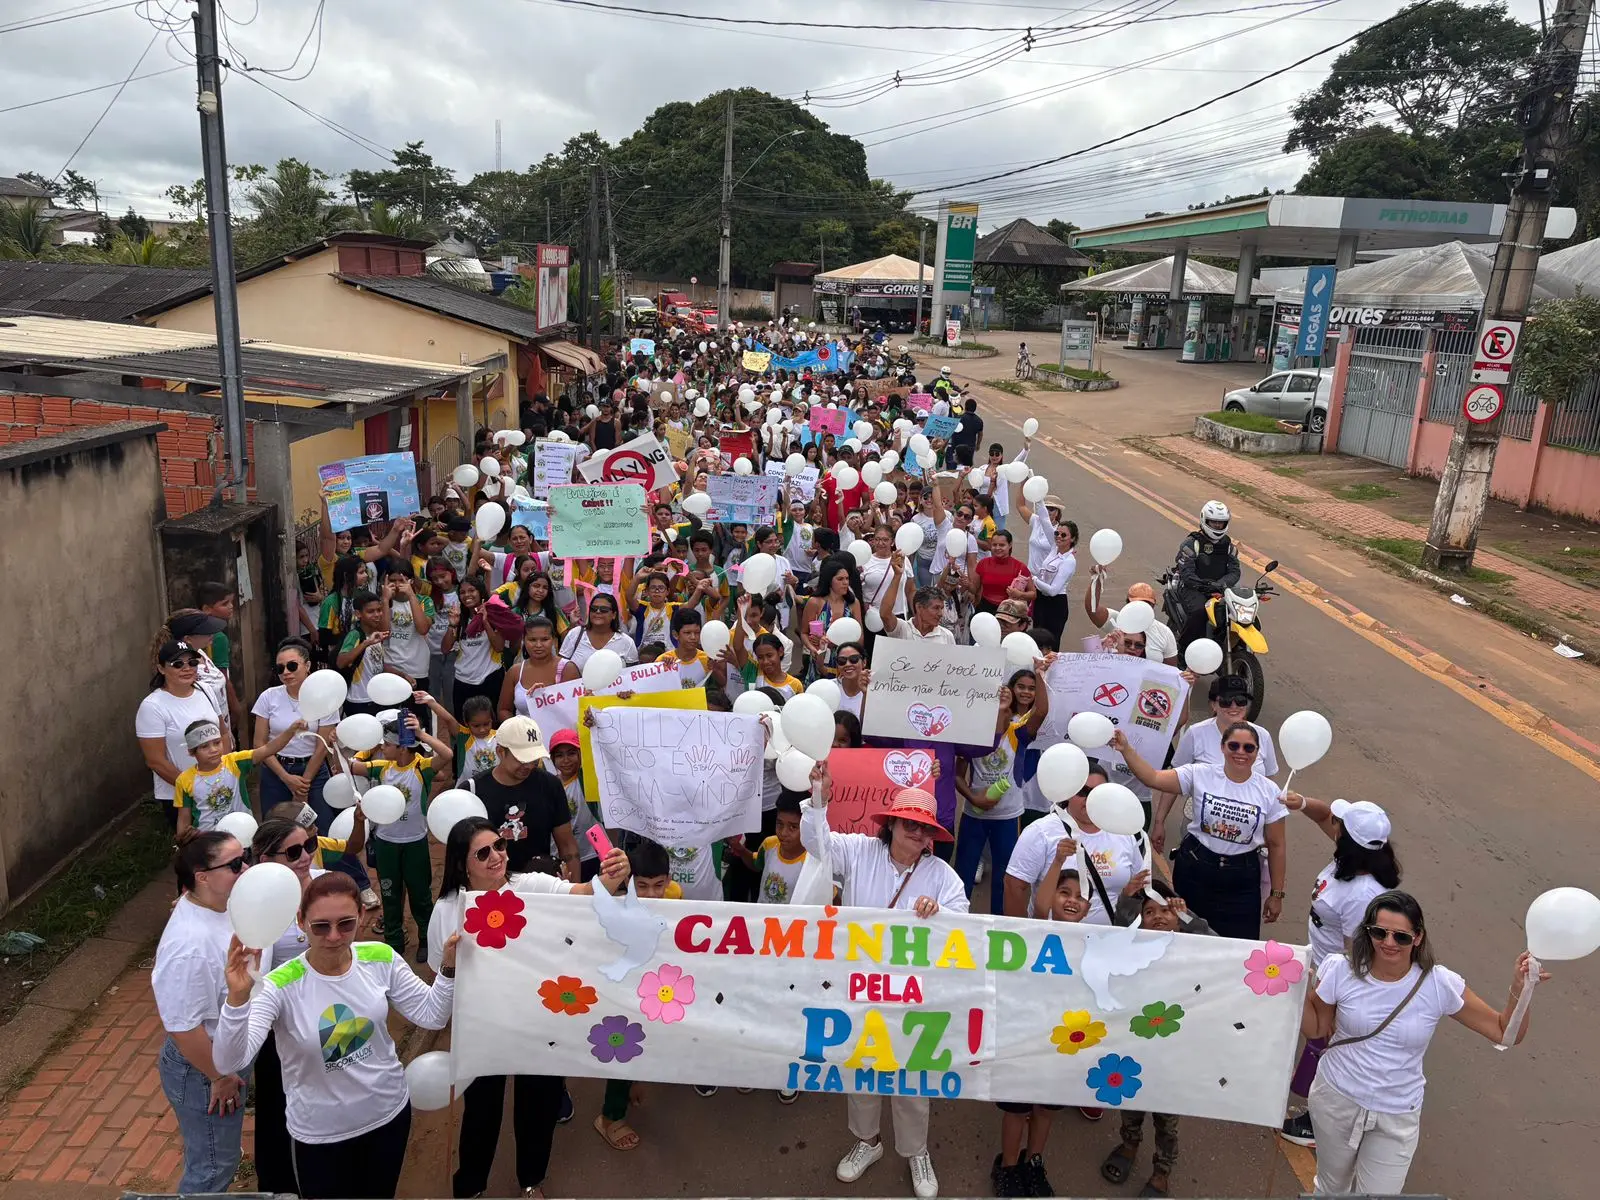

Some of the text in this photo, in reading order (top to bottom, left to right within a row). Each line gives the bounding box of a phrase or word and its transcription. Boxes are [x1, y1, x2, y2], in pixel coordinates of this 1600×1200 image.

[951, 214, 973, 229] BR
[1379, 208, 1469, 224] PETROBRAS
[883, 284, 926, 294] Gomes
[1328, 306, 1388, 325] omes
[590, 448, 666, 485] ULLYING
[768, 469, 814, 482] CONSUTORES
[566, 486, 608, 499] BULLYING
[890, 656, 915, 672] Se
[924, 659, 942, 672] só
[946, 664, 977, 676] você
[870, 672, 908, 692] então
[912, 685, 933, 696] não
[938, 680, 960, 697] teve
[535, 692, 565, 708] DIGA
[526, 728, 538, 742] NY
[594, 711, 744, 748] BULLYING
[599, 744, 688, 776] NÃO É
[604, 769, 761, 808] BEM-VINDO!
[1214, 801, 1256, 816] IMPORTÂNCIA
[1223, 808, 1248, 818] FAMÍLIA
[1222, 814, 1250, 824] ESCOLA
[1090, 854, 1107, 864] 026
[672, 873, 695, 884] CRE
[674, 904, 1073, 976] CAMINHADA
[849, 972, 923, 1003] PELA
[798, 1007, 984, 1072] PAZ!
[786, 1062, 962, 1098] IZA MELLO
